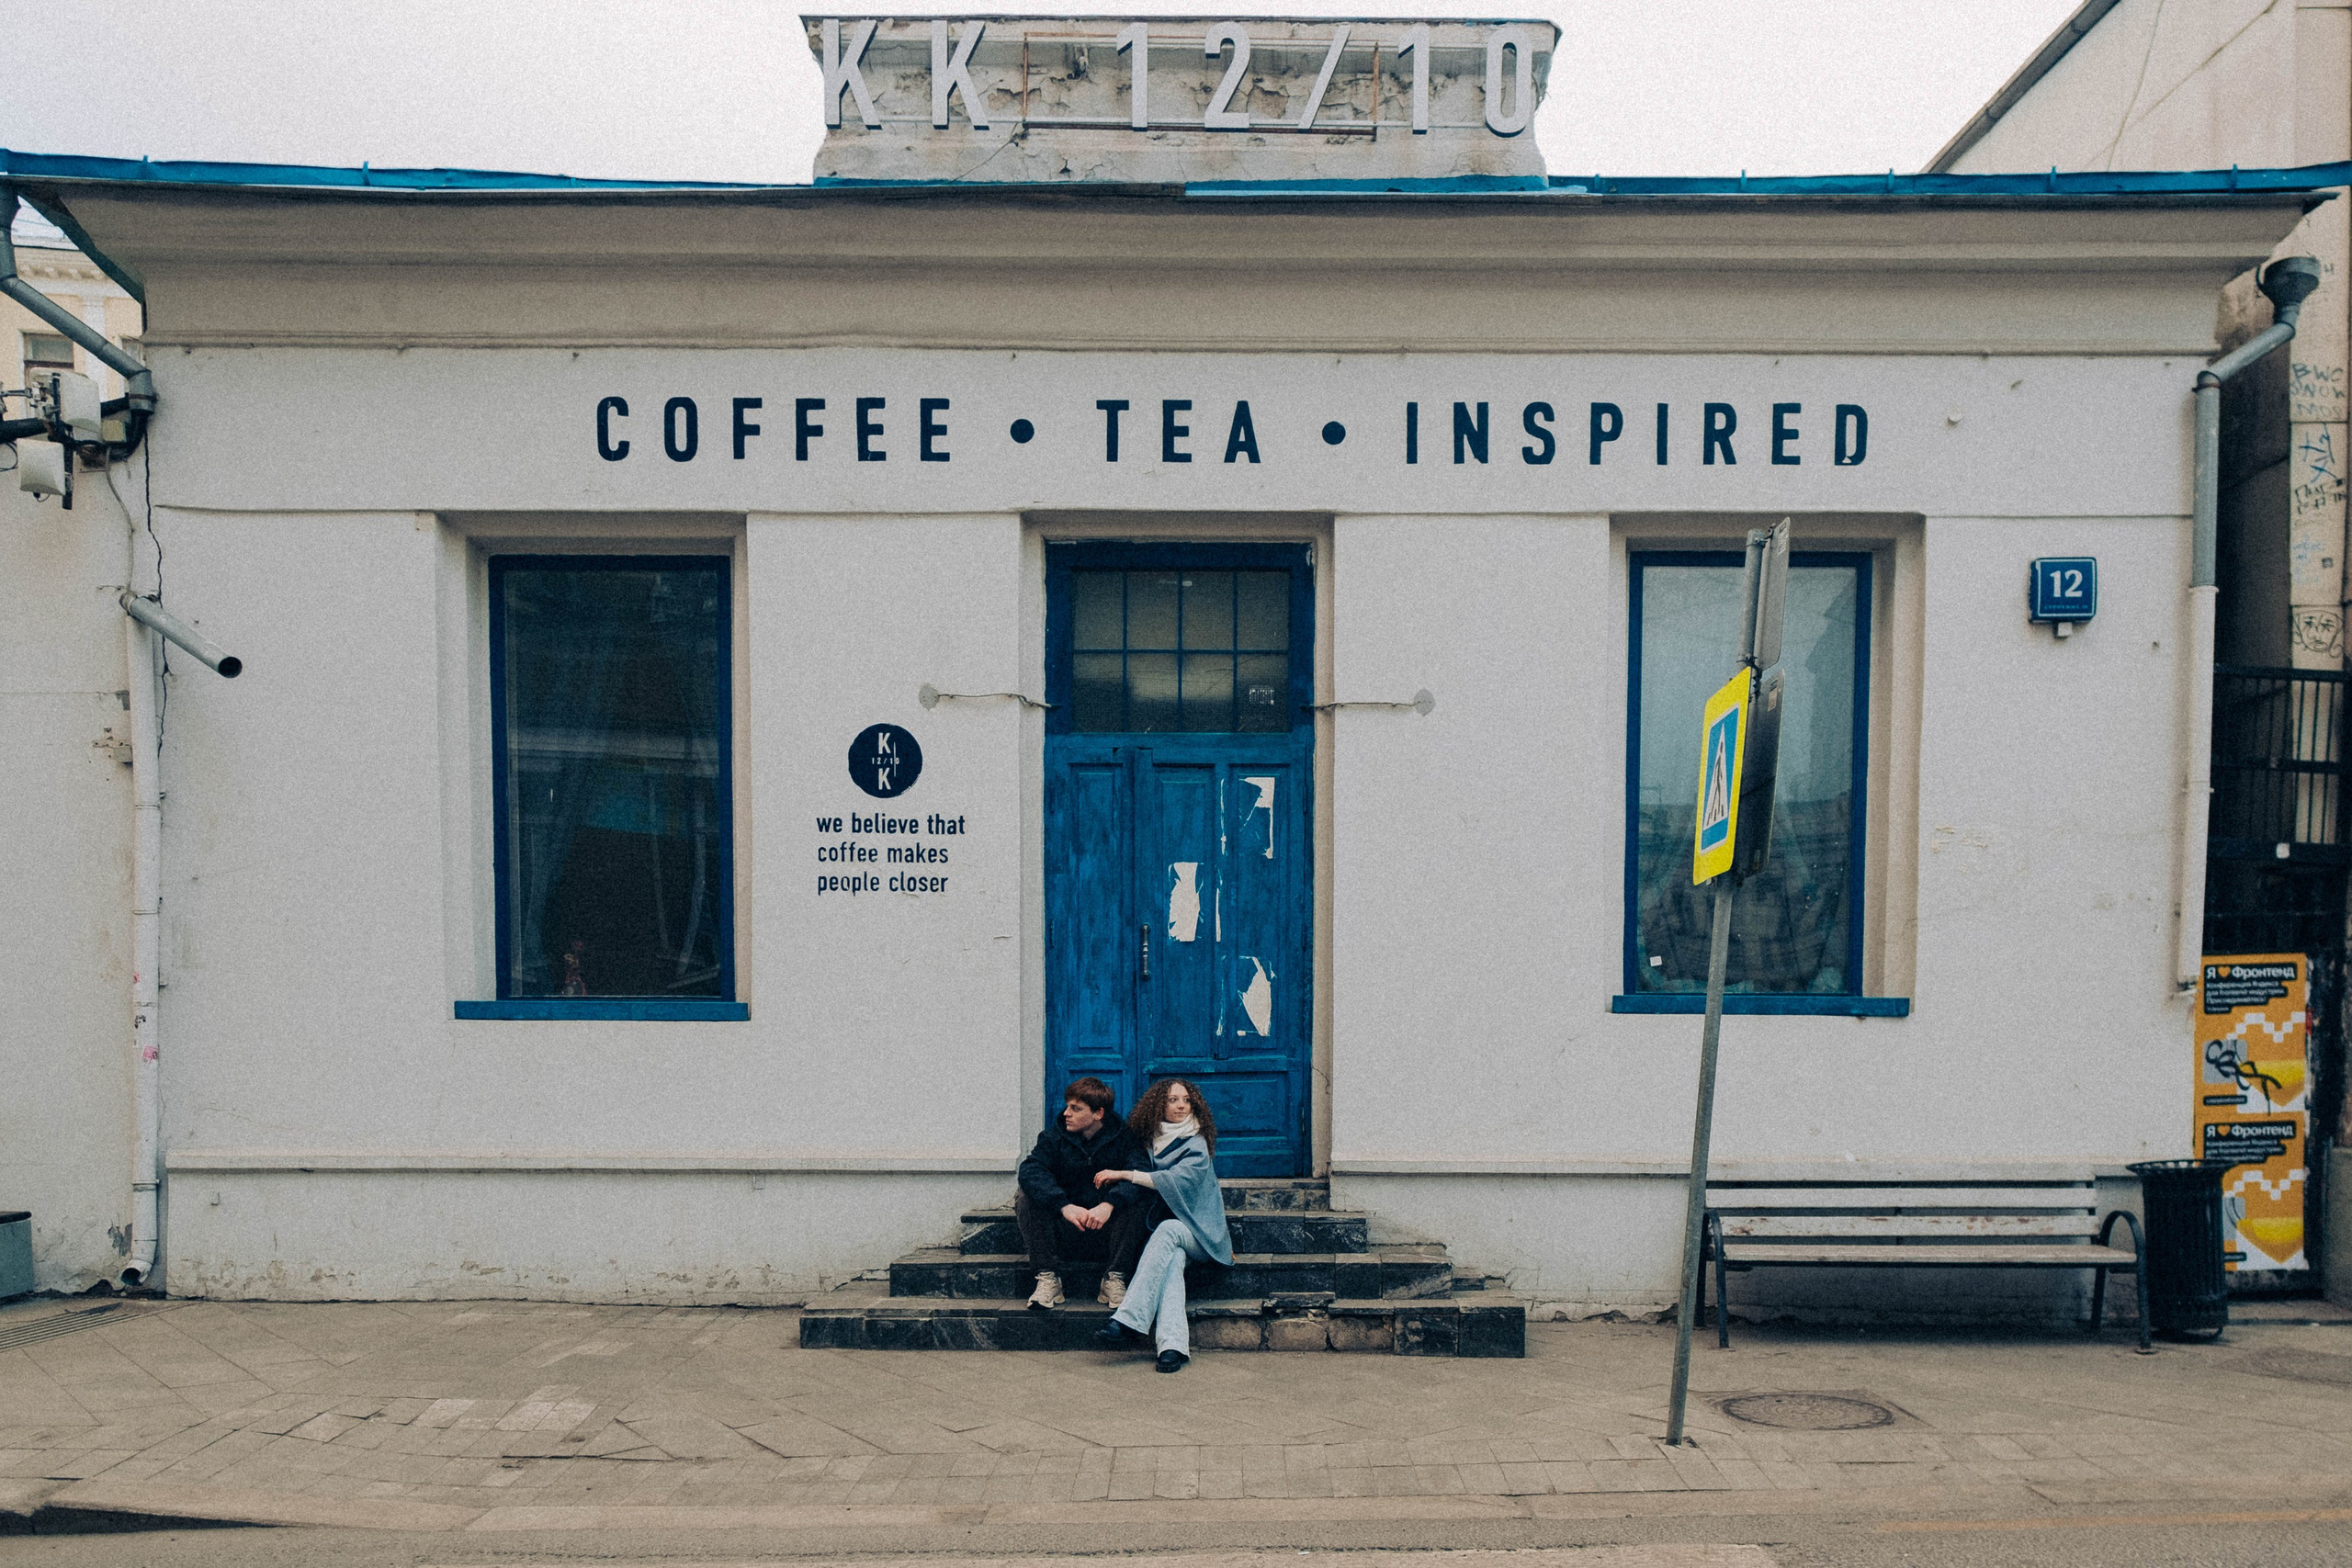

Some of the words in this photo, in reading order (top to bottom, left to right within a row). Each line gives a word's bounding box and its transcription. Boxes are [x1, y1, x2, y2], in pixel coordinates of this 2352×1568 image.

[1115, 22, 1533, 138] 12/10
[596, 396, 951, 463] COFFEE
[1096, 400, 1261, 464] TEA
[1406, 401, 1869, 466] INSPIRED
[2050, 570, 2083, 598] 12
[877, 732, 891, 755] K
[877, 767, 891, 790] K
[816, 817, 842, 833] we
[852, 812, 920, 834] believe
[927, 814, 966, 835] that
[818, 841, 878, 863] coffee
[888, 842, 949, 863] makes
[818, 871, 880, 897] people
[888, 871, 949, 892] closer
[2207, 966, 2216, 979] Я
[2232, 965, 2295, 981] Фронтенд
[2207, 1125, 2216, 1138] Я
[2231, 1123, 2293, 1139] Фронтенд
